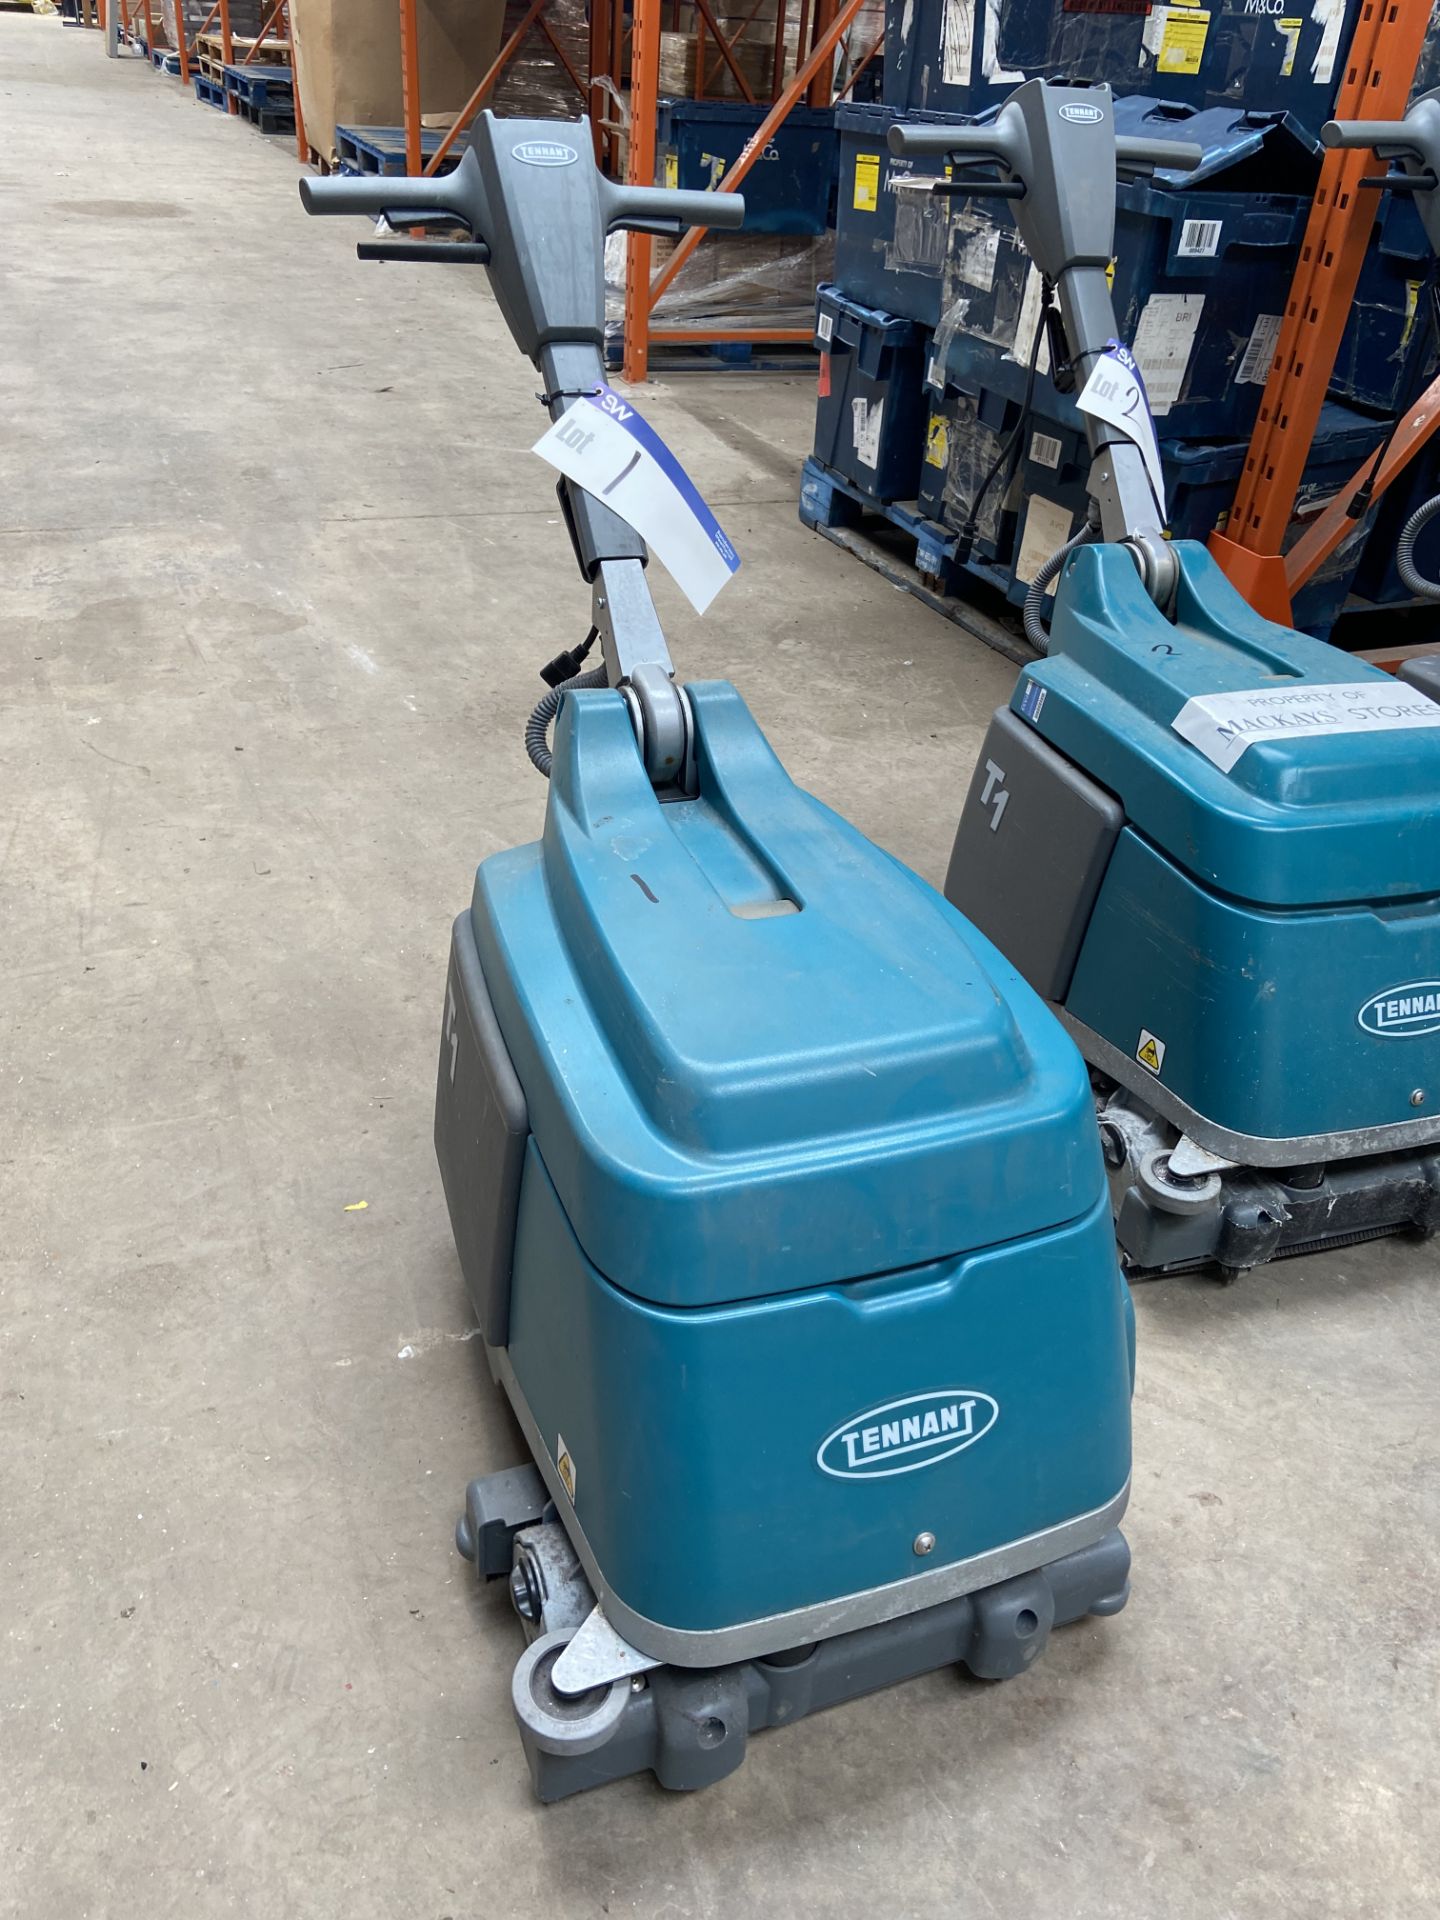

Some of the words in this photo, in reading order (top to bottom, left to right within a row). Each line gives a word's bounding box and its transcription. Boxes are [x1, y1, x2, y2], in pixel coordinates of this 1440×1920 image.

[1065, 107, 1098, 119] TENNANT
[521, 145, 569, 160] TENNANT
[1091, 373, 1120, 401] Lot
[1121, 386, 1140, 420] 2
[555, 418, 596, 455] Lot
[602, 449, 642, 495] 1
[1248, 690, 1335, 707] PROPERTY
[1341, 690, 1366, 699] OF
[1216, 710, 1338, 742] MACKAYS
[1347, 703, 1440, 720] STORES
[980, 758, 1010, 832] T1
[446, 981, 458, 1085] T1
[841, 1400, 976, 1467] TENNANT
